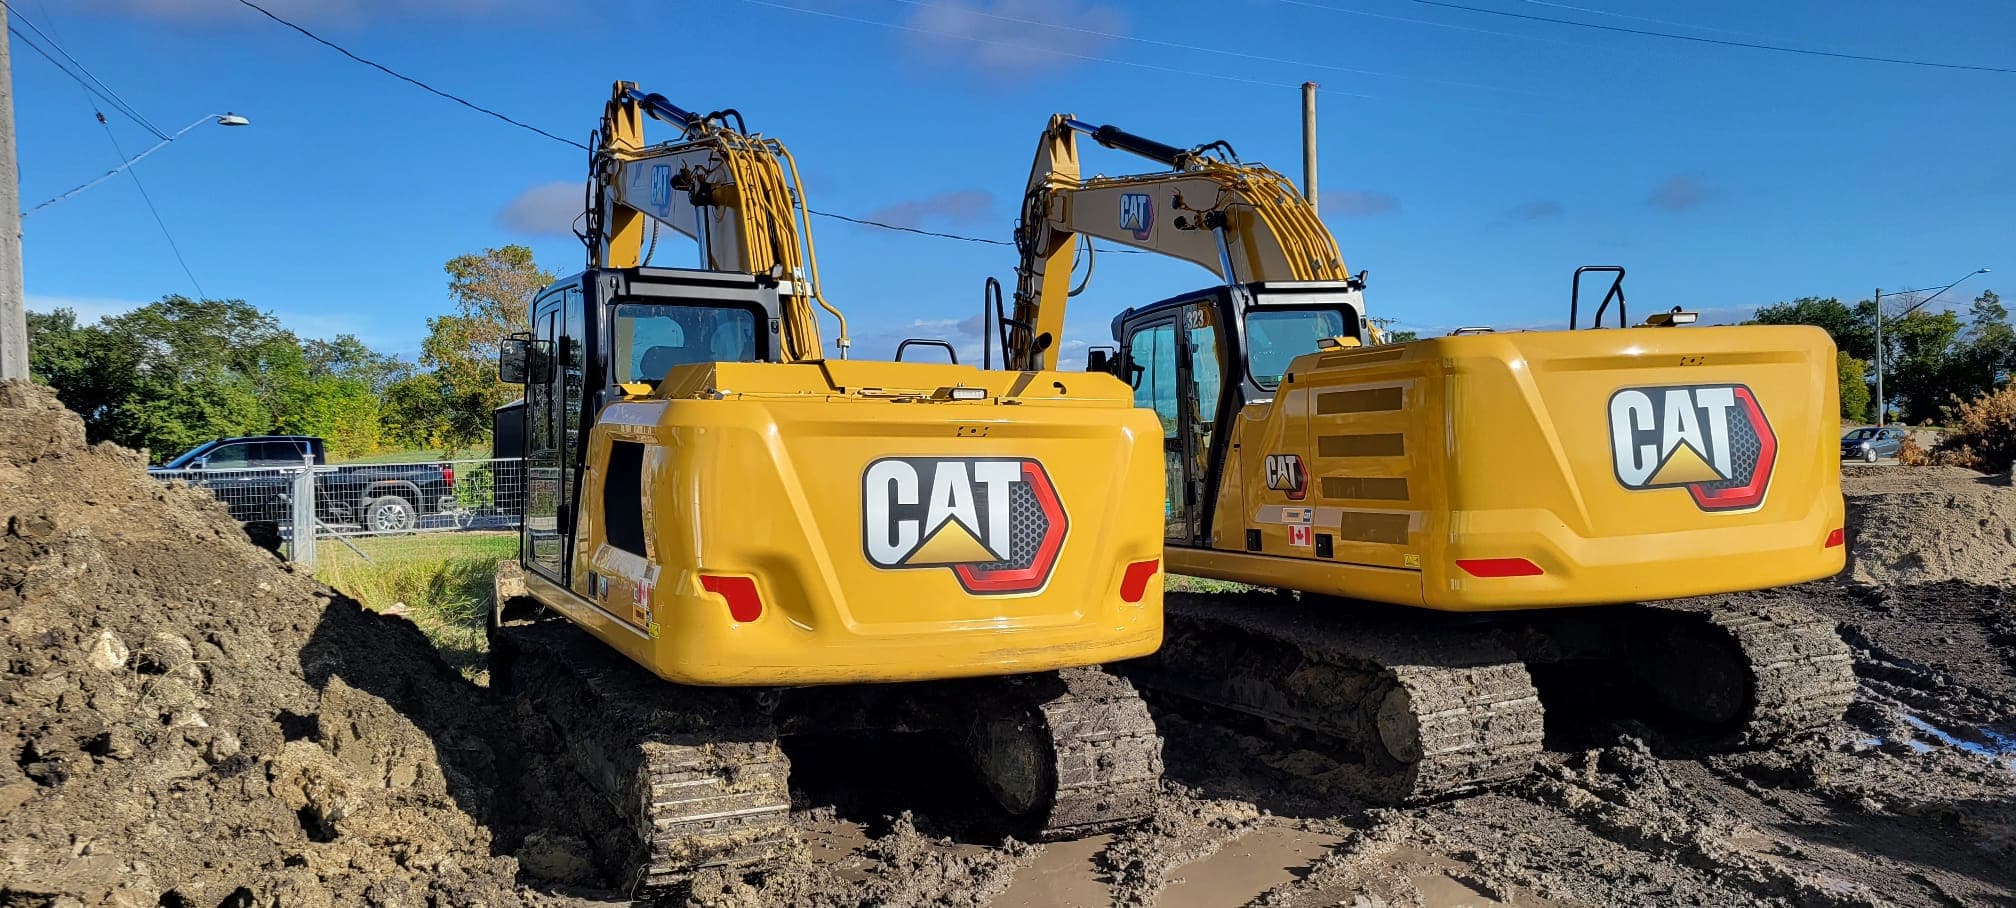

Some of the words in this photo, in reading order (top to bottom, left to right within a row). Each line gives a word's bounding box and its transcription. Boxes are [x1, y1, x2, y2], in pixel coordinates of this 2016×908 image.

[652, 167, 669, 205] CAT
[1120, 195, 1147, 229] CAT
[1187, 310, 1204, 329] 323
[1611, 388, 1735, 486] CAT
[1265, 455, 1297, 489] CAT
[866, 460, 1021, 565] CAT
